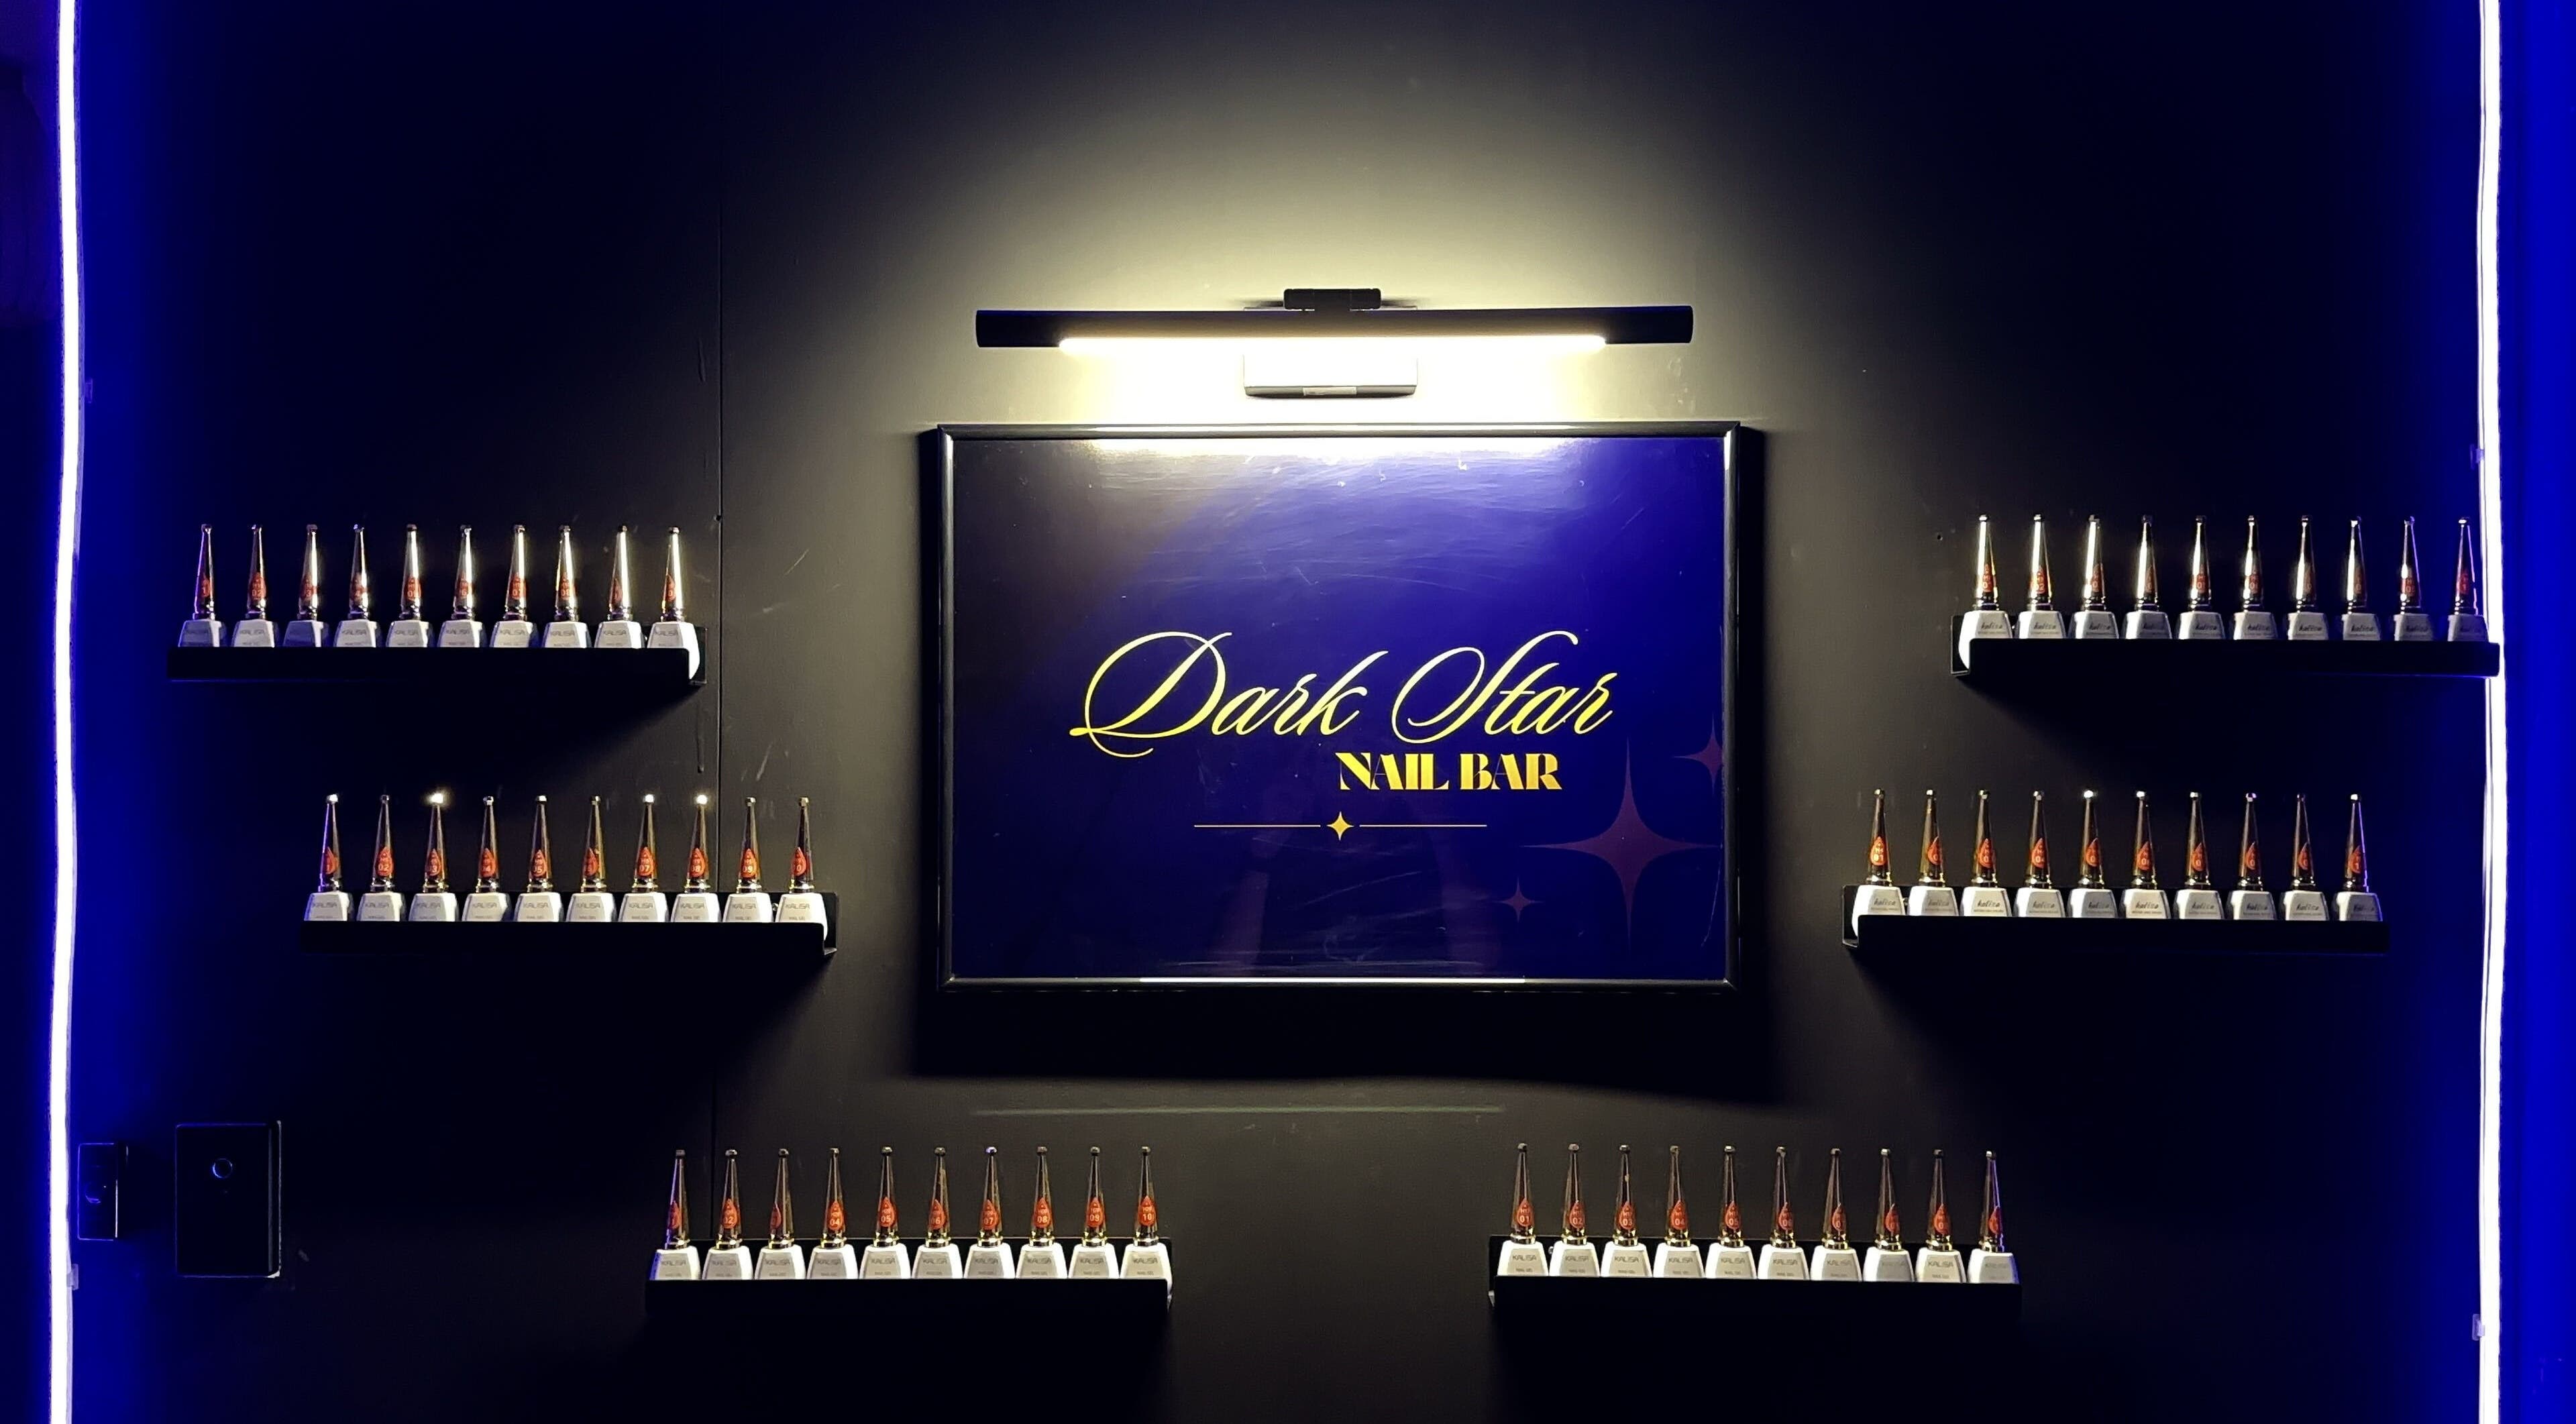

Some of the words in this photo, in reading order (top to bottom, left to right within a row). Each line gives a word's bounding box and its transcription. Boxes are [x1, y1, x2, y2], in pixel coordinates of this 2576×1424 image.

[1069, 631, 1389, 757] Dark
[1392, 631, 1617, 744] Star
[1336, 753, 1449, 790] NAIL
[1460, 753, 1562, 790] BAR
